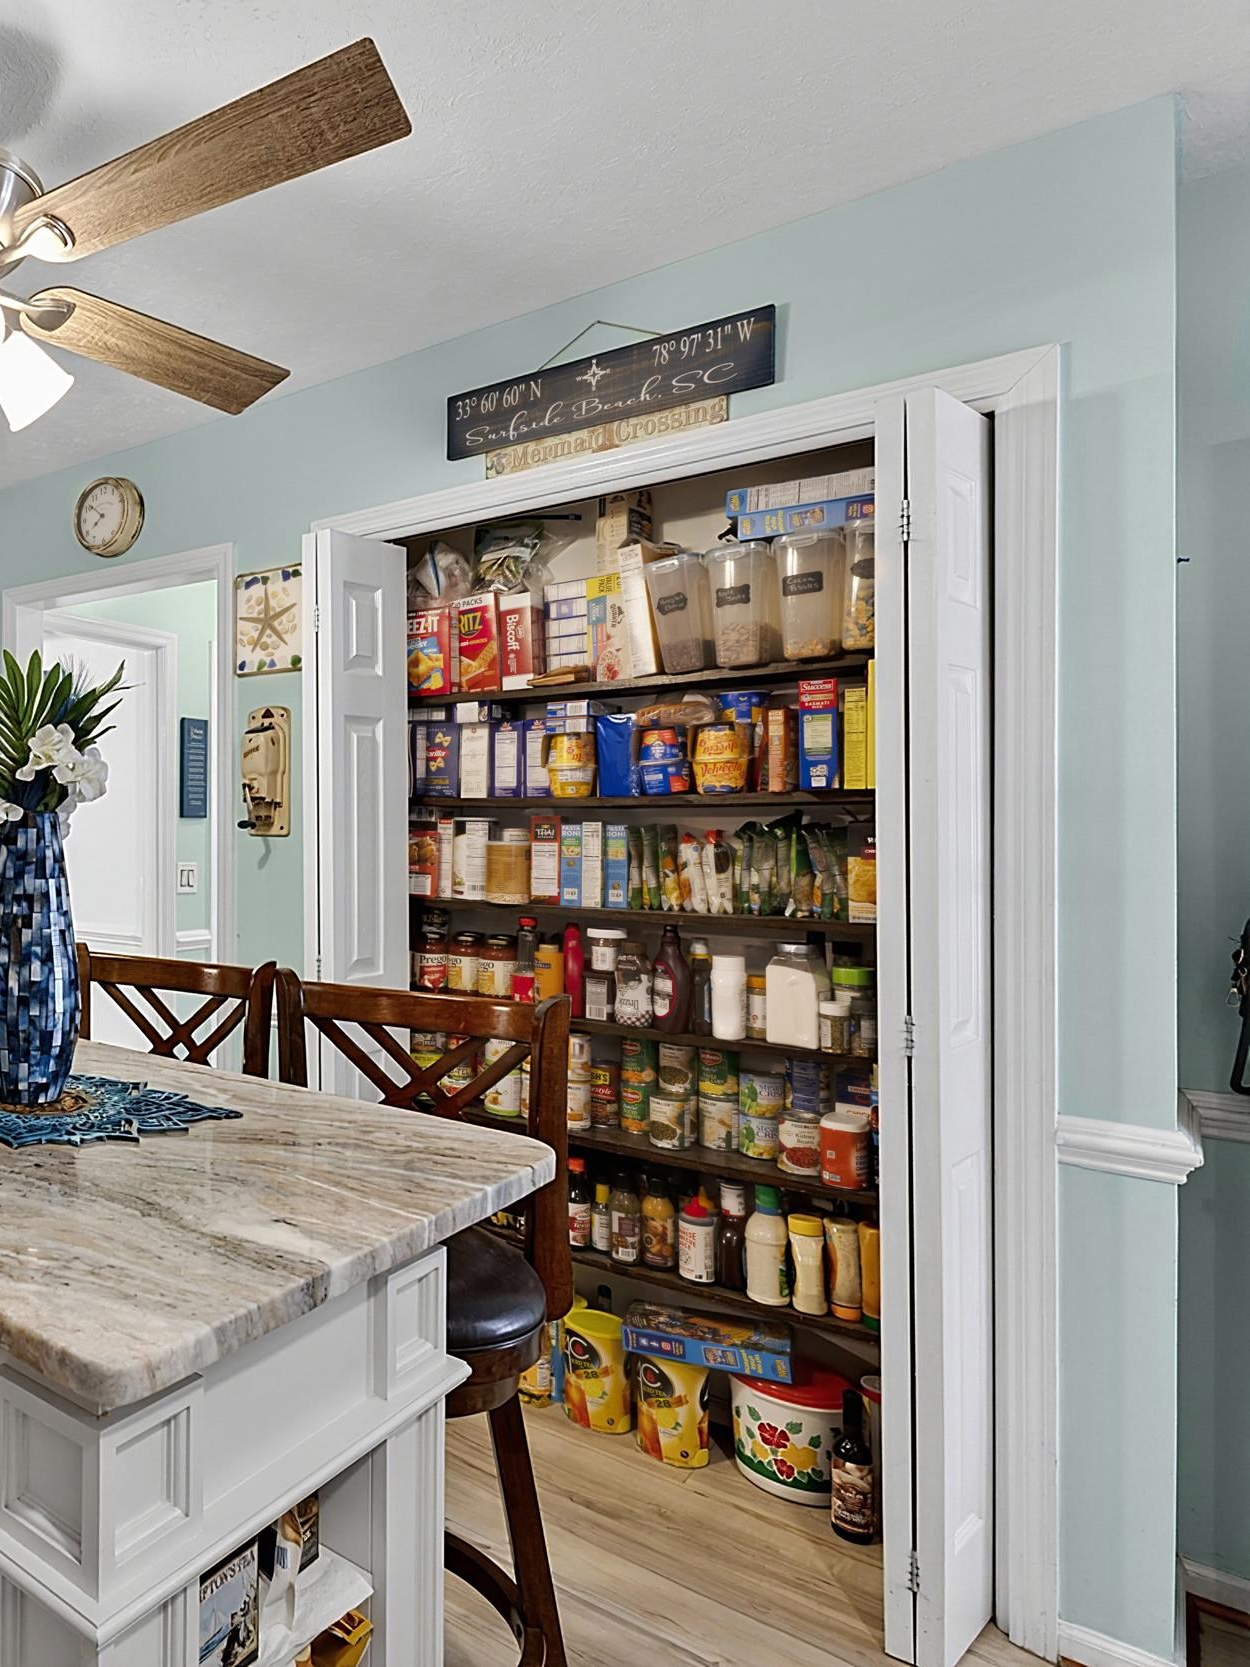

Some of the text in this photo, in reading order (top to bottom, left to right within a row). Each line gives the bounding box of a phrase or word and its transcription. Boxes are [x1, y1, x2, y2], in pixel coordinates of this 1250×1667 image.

[737, 317, 756, 343] W
[530, 379, 542, 400] N
[466, 401, 565, 446] Surfside
[672, 362, 737, 394] SC
[511, 394, 726, 468] Mermaid Crossing
[463, 598, 483, 608] PACKS
[609, 603, 617, 628] QUAKER
[408, 616, 440, 634] EEZ-IT
[506, 614, 521, 652] Biscoff
[802, 682, 833, 691] Success
[701, 761, 743, 778] Velveeta
[535, 828, 555, 836] THAI
[419, 955, 447, 965] Prego
[590, 1071, 608, 1083] SH'S
[756, 1125, 778, 1133] Stea
[795, 1132, 815, 1140] Kidney
[583, 1370, 599, 1379] 28
[655, 1400, 671, 1408] 28
